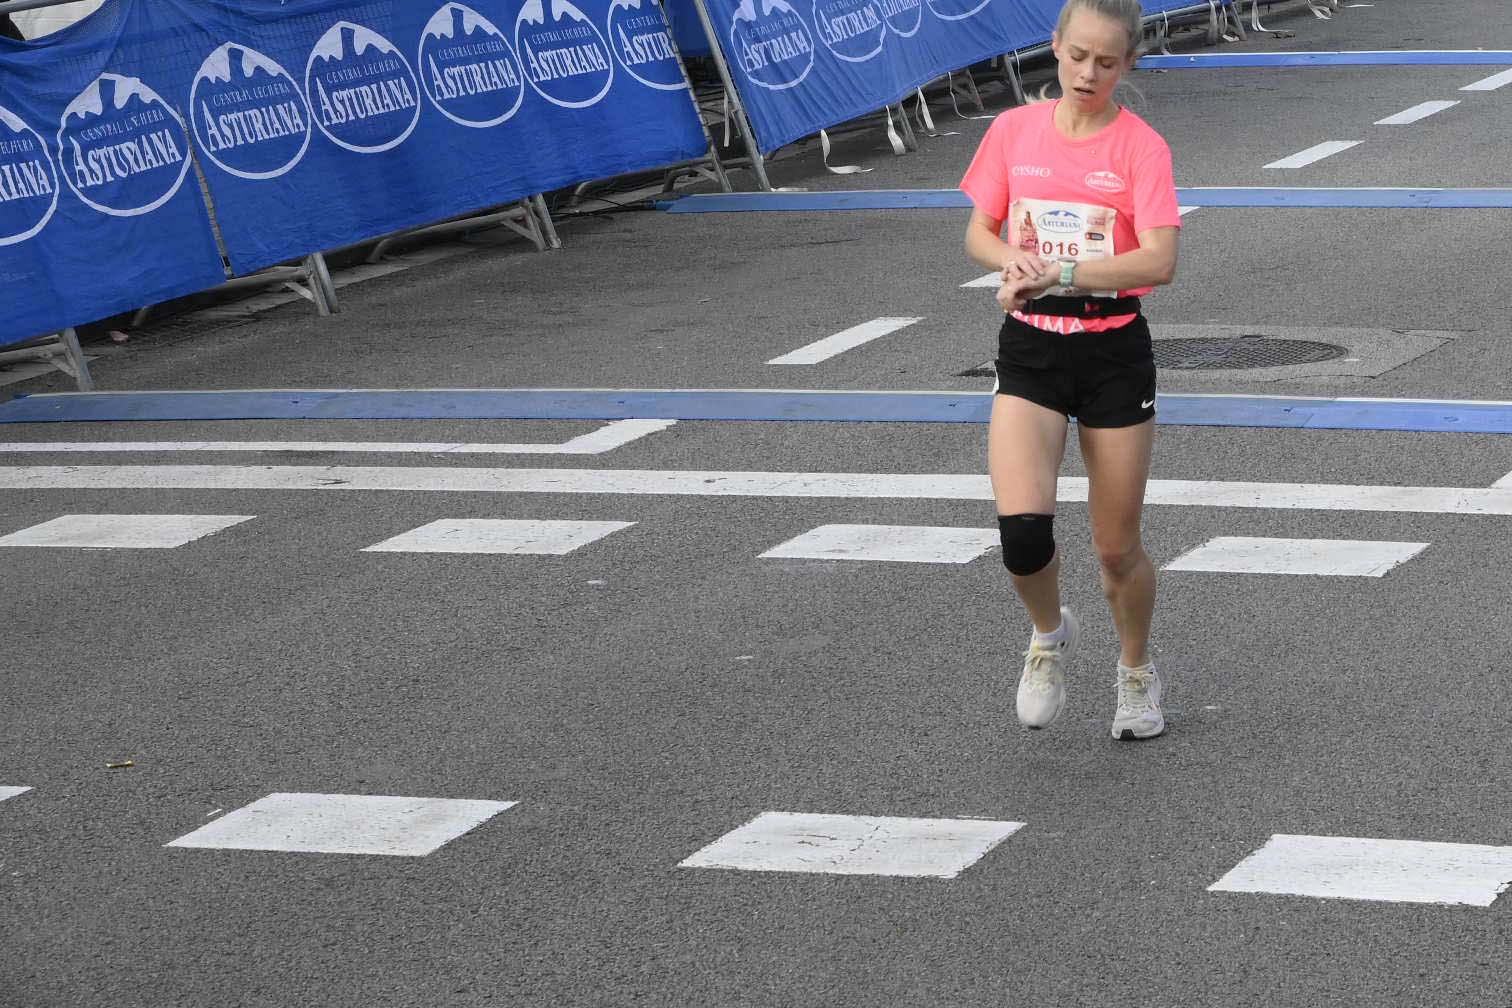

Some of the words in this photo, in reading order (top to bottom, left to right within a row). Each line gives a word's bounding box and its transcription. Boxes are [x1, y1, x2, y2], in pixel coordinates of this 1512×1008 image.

[326, 67, 362, 85] CENTRAL
[364, 59, 400, 79] LECHERA
[428, 53, 519, 102] ASTURIANA
[523, 37, 608, 83] ASTURIANA
[213, 87, 252, 107] CENTRAL
[253, 80, 291, 100] LECHERA
[315, 75, 416, 127] ASTURIANA
[202, 99, 306, 152] ASTURIANA
[1042, 241, 1079, 257] 016
